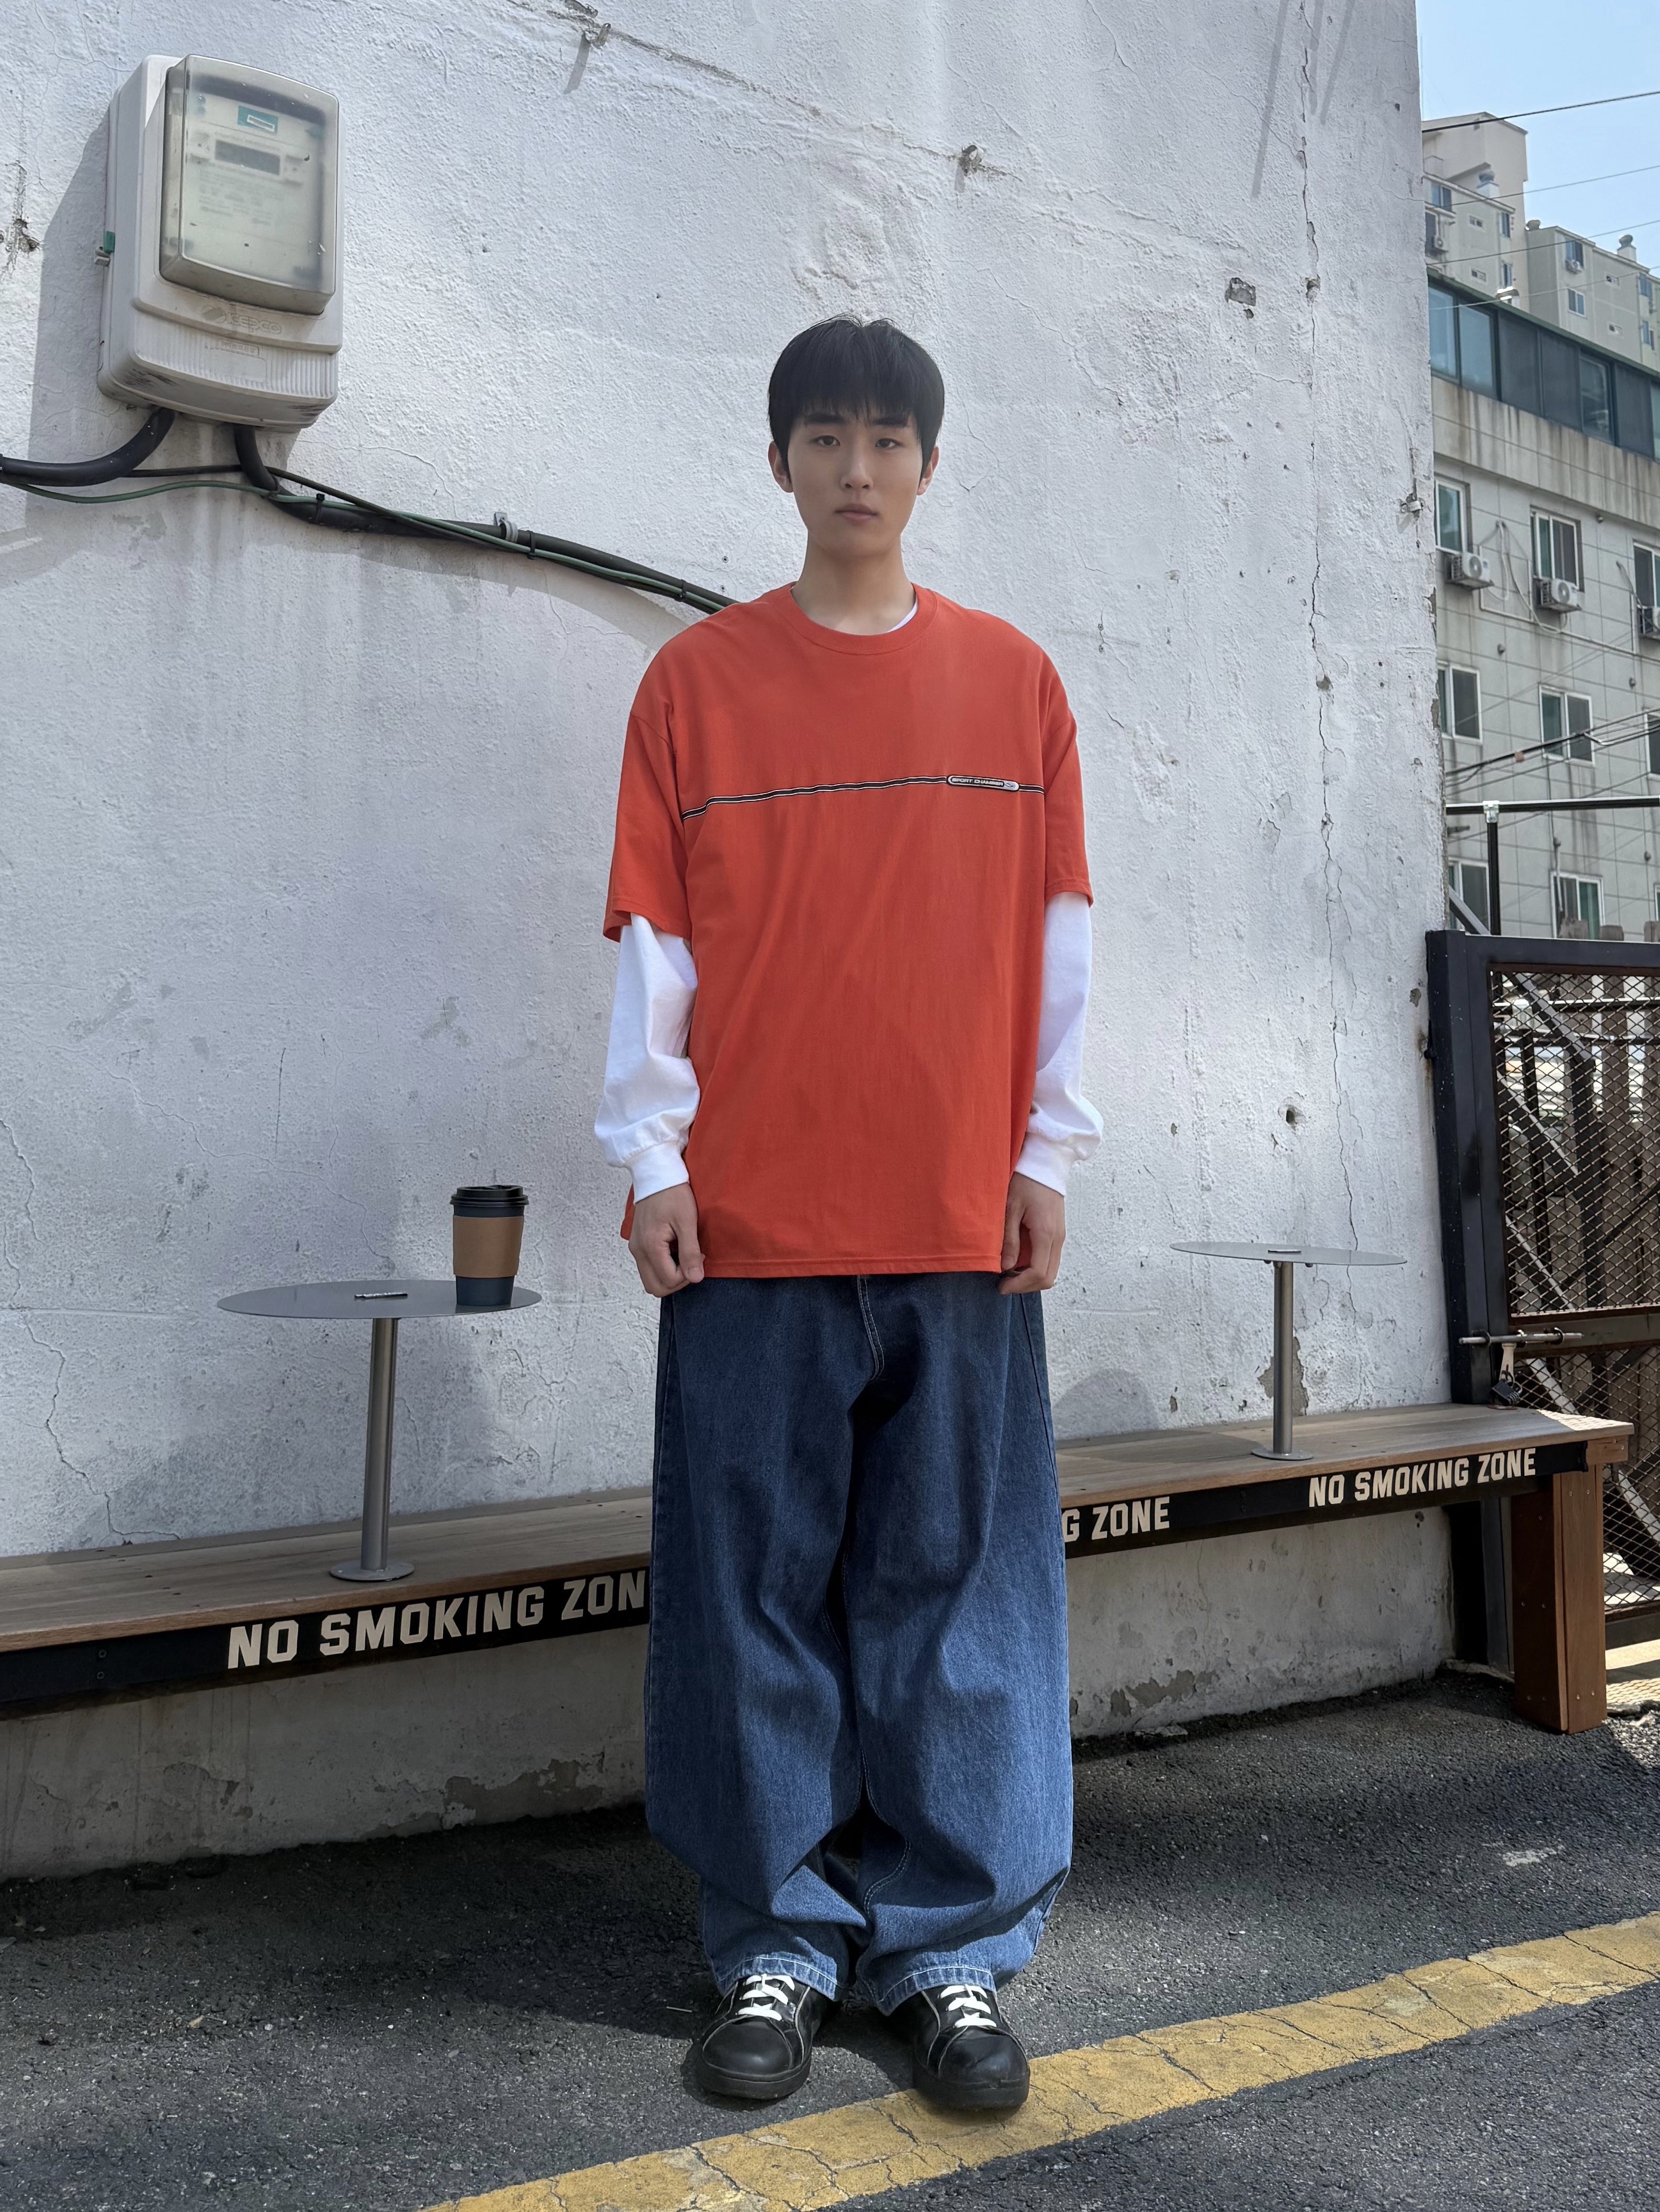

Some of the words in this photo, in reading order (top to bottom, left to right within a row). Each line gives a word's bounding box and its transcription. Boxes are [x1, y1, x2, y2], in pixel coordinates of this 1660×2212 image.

[1309, 1474, 1345, 1507] NO
[1354, 1458, 1469, 1501] SMOKING
[1477, 1448, 1536, 1483] ZONE
[1091, 1496, 1170, 1540] ZONE
[228, 1619, 299, 1669] NO
[319, 1586, 545, 1656] SMOKING
[561, 1570, 646, 1620] ZON
